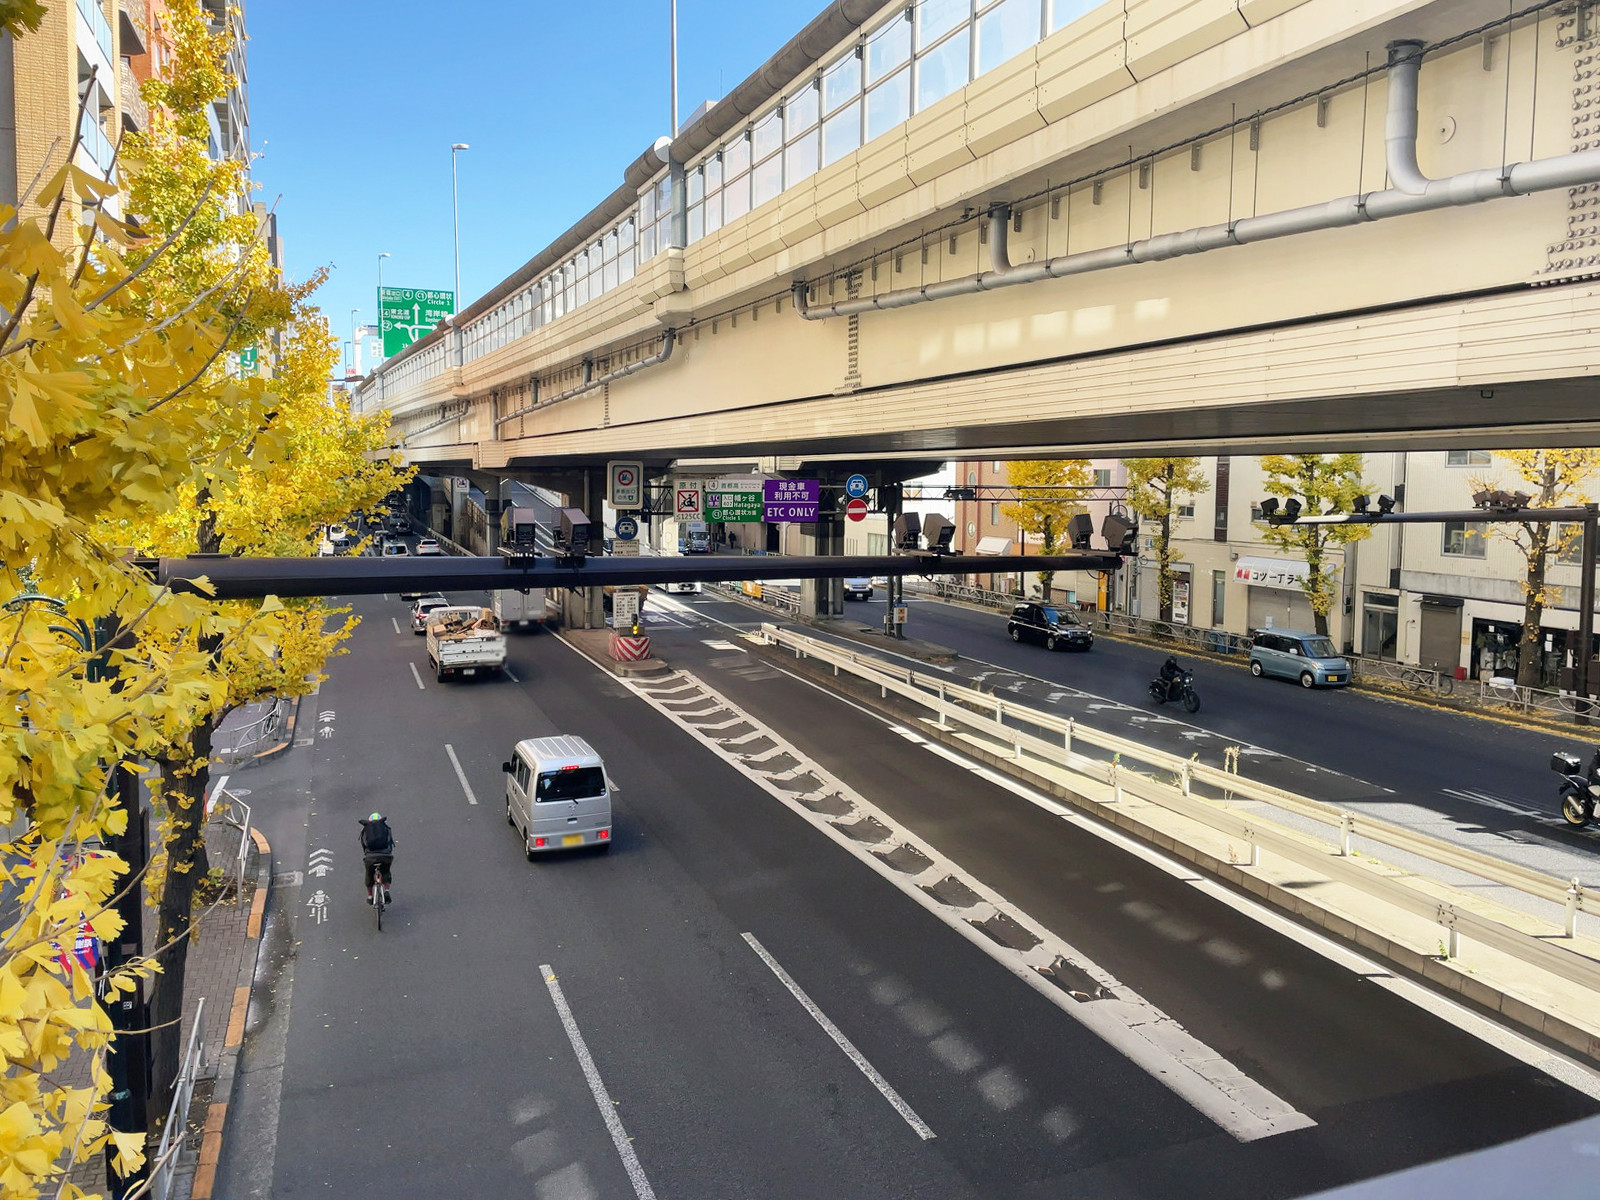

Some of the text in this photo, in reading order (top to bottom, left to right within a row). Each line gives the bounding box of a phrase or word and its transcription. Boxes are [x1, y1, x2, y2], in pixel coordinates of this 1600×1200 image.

[427, 291, 453, 300] 都心環状
[779, 482, 805, 491] 現金車
[774, 491, 809, 501] 利用不可
[767, 507, 815, 517] ETC ONLY
